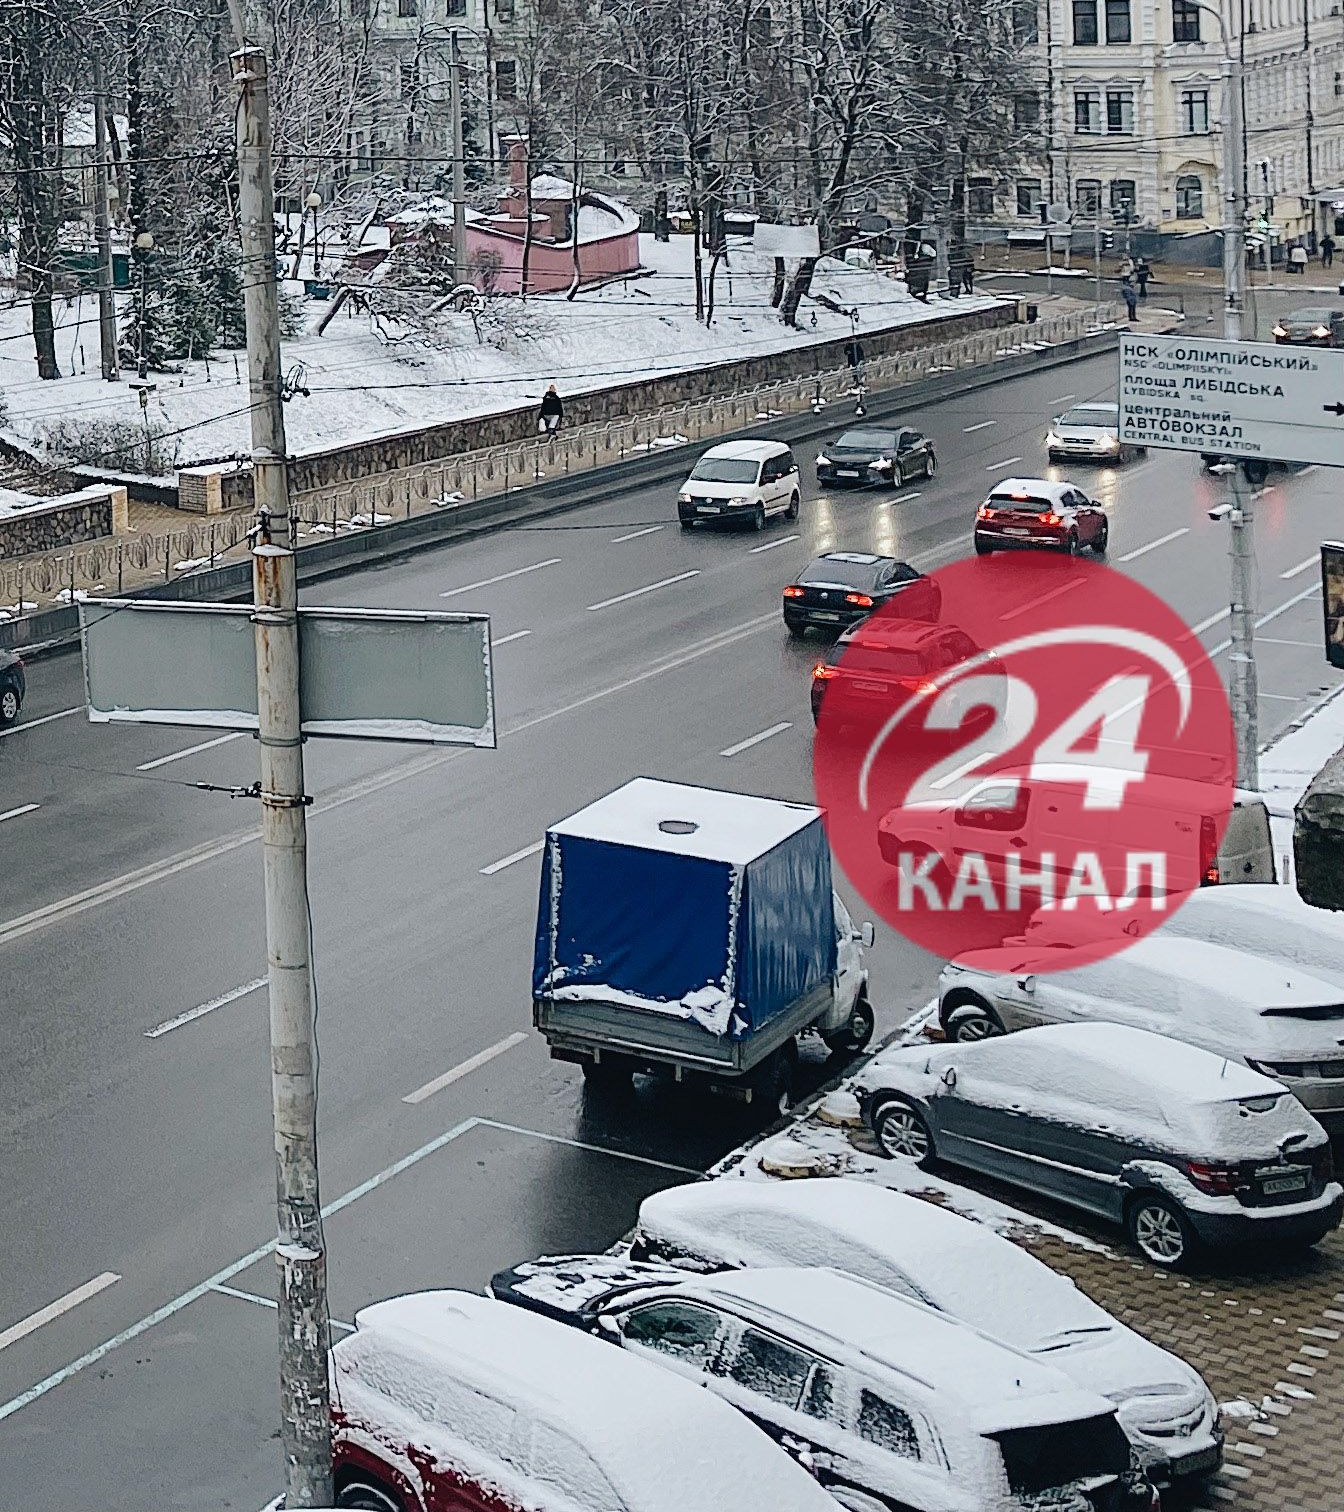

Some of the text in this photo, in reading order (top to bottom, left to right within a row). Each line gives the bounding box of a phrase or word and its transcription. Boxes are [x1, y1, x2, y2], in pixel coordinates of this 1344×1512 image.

[1124, 344, 1159, 358] НСК
[1124, 359, 1147, 369] NSC
[1124, 387, 1181, 399] LYBIDSKA
[1125, 375, 1285, 397] площа ЛИБІДСЬКА
[1125, 404, 1231, 423] центральний
[1125, 416, 1243, 438] АВТОВОКЗАЛ
[1124, 430, 1261, 451] CENTRAL BUS STATION
